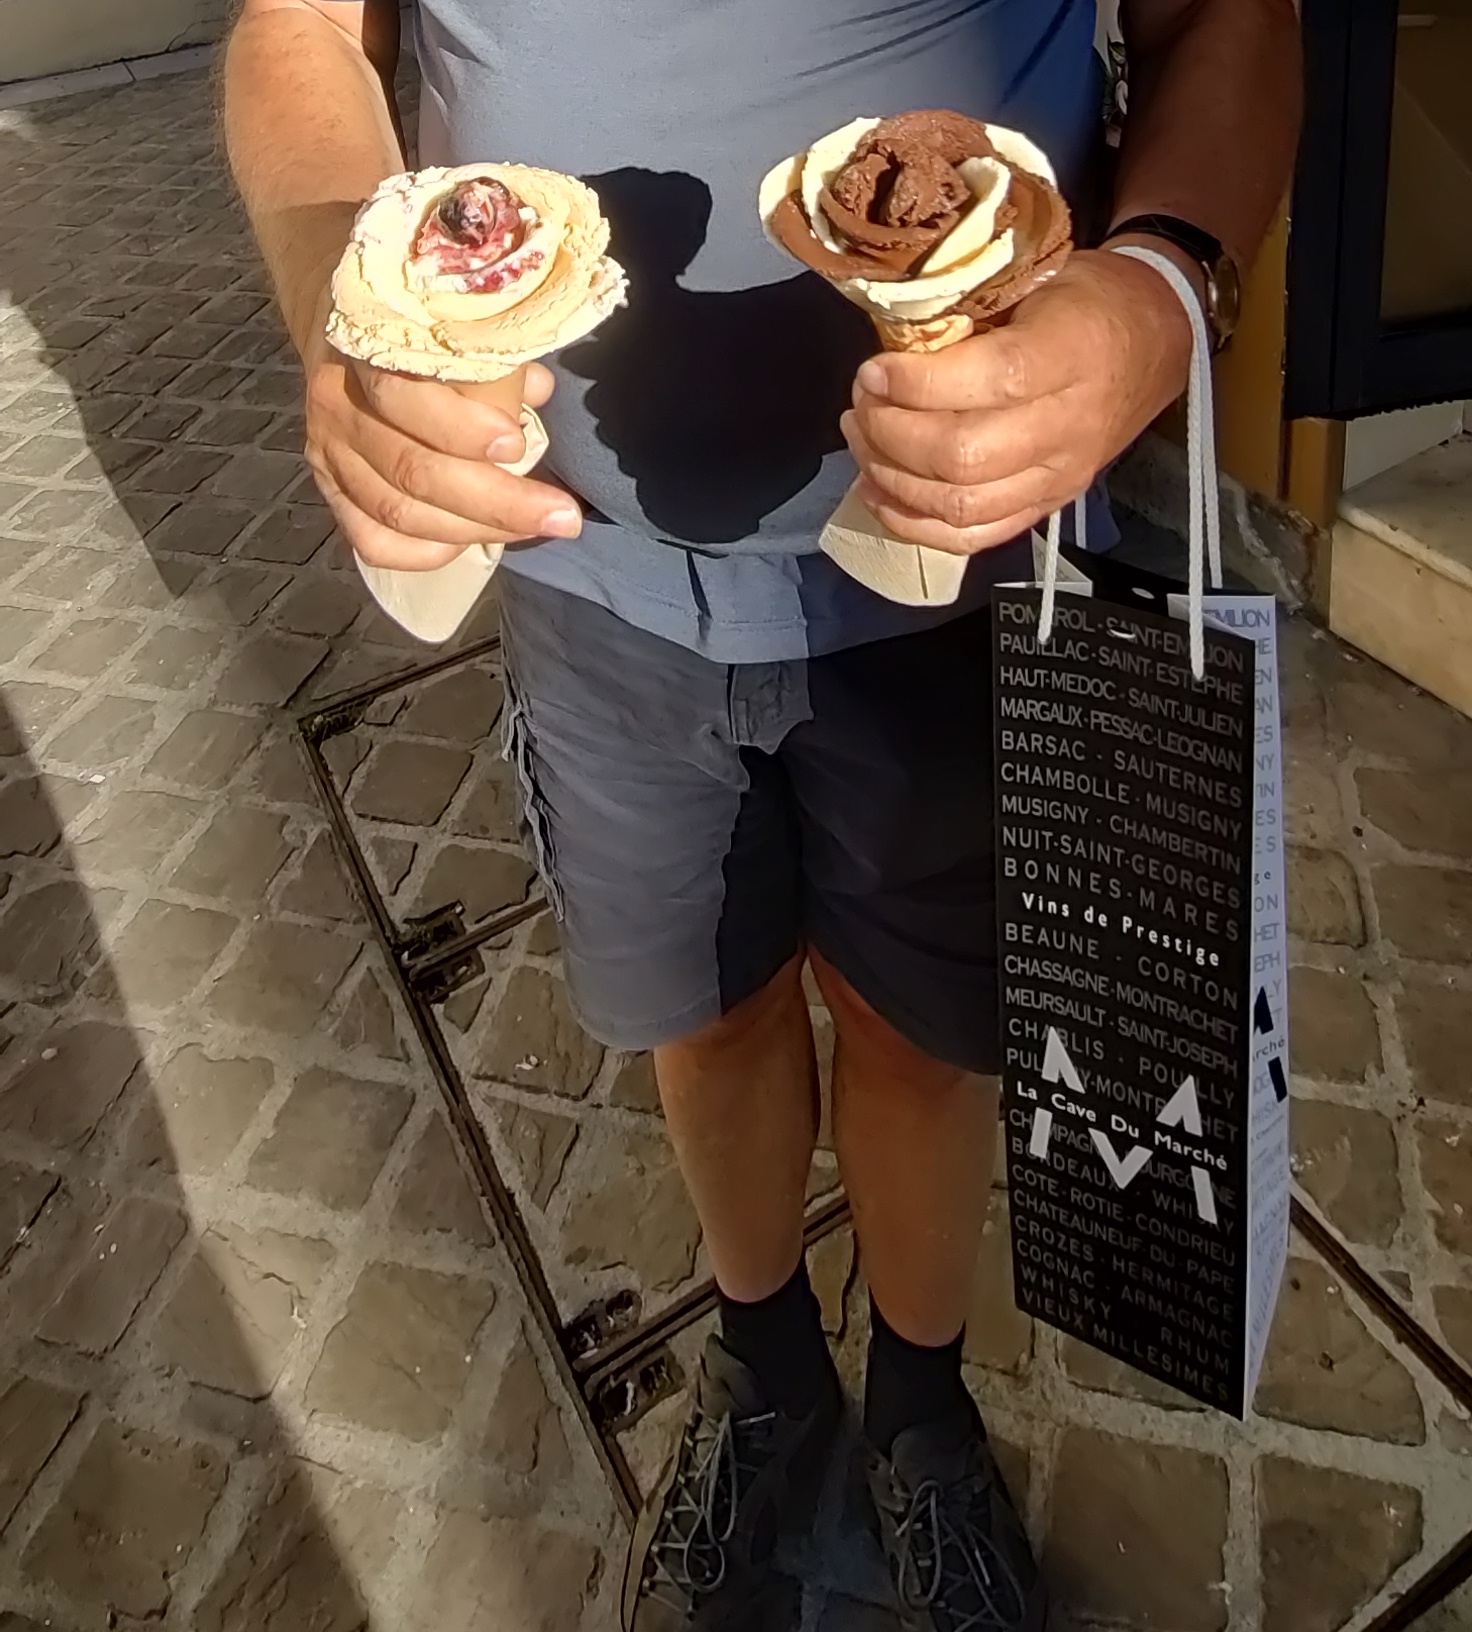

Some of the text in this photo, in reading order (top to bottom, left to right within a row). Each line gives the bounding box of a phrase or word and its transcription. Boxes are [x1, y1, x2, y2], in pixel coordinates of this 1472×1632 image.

[998, 601, 1096, 633] POMROL
[1000, 665, 1117, 701] HAUT-MEDOC
[1000, 762, 1242, 842] CHAMBOLLE MUSIGNY
[1001, 729, 1242, 808] BARSAC SAUTERNES
[1002, 794, 1089, 825] MUSIGNY
[1109, 814, 1241, 875] CHAMBERTIN
[1004, 922, 1100, 960] BEAUNE
[1137, 955, 1238, 1011] CORTON
[1021, 891, 1220, 967] Vins de Prestige
[1005, 986, 1107, 1028] MEURSAULT
[1138, 1056, 1235, 1111] POULLY
[1016, 1080, 1228, 1172] La Cave Du Marché
[1135, 1212, 1236, 1268] CONDRIEU
[1151, 1189, 1235, 1236] WHIY
[1014, 1214, 1235, 1324] CROZES HERMITAGE
[1016, 1238, 1233, 1349] COGNAC ARMAGNAC
[1020, 1263, 1230, 1375] WHISKY RHUM
[1021, 1286, 1230, 1402] VIEUX MILLESIMES
